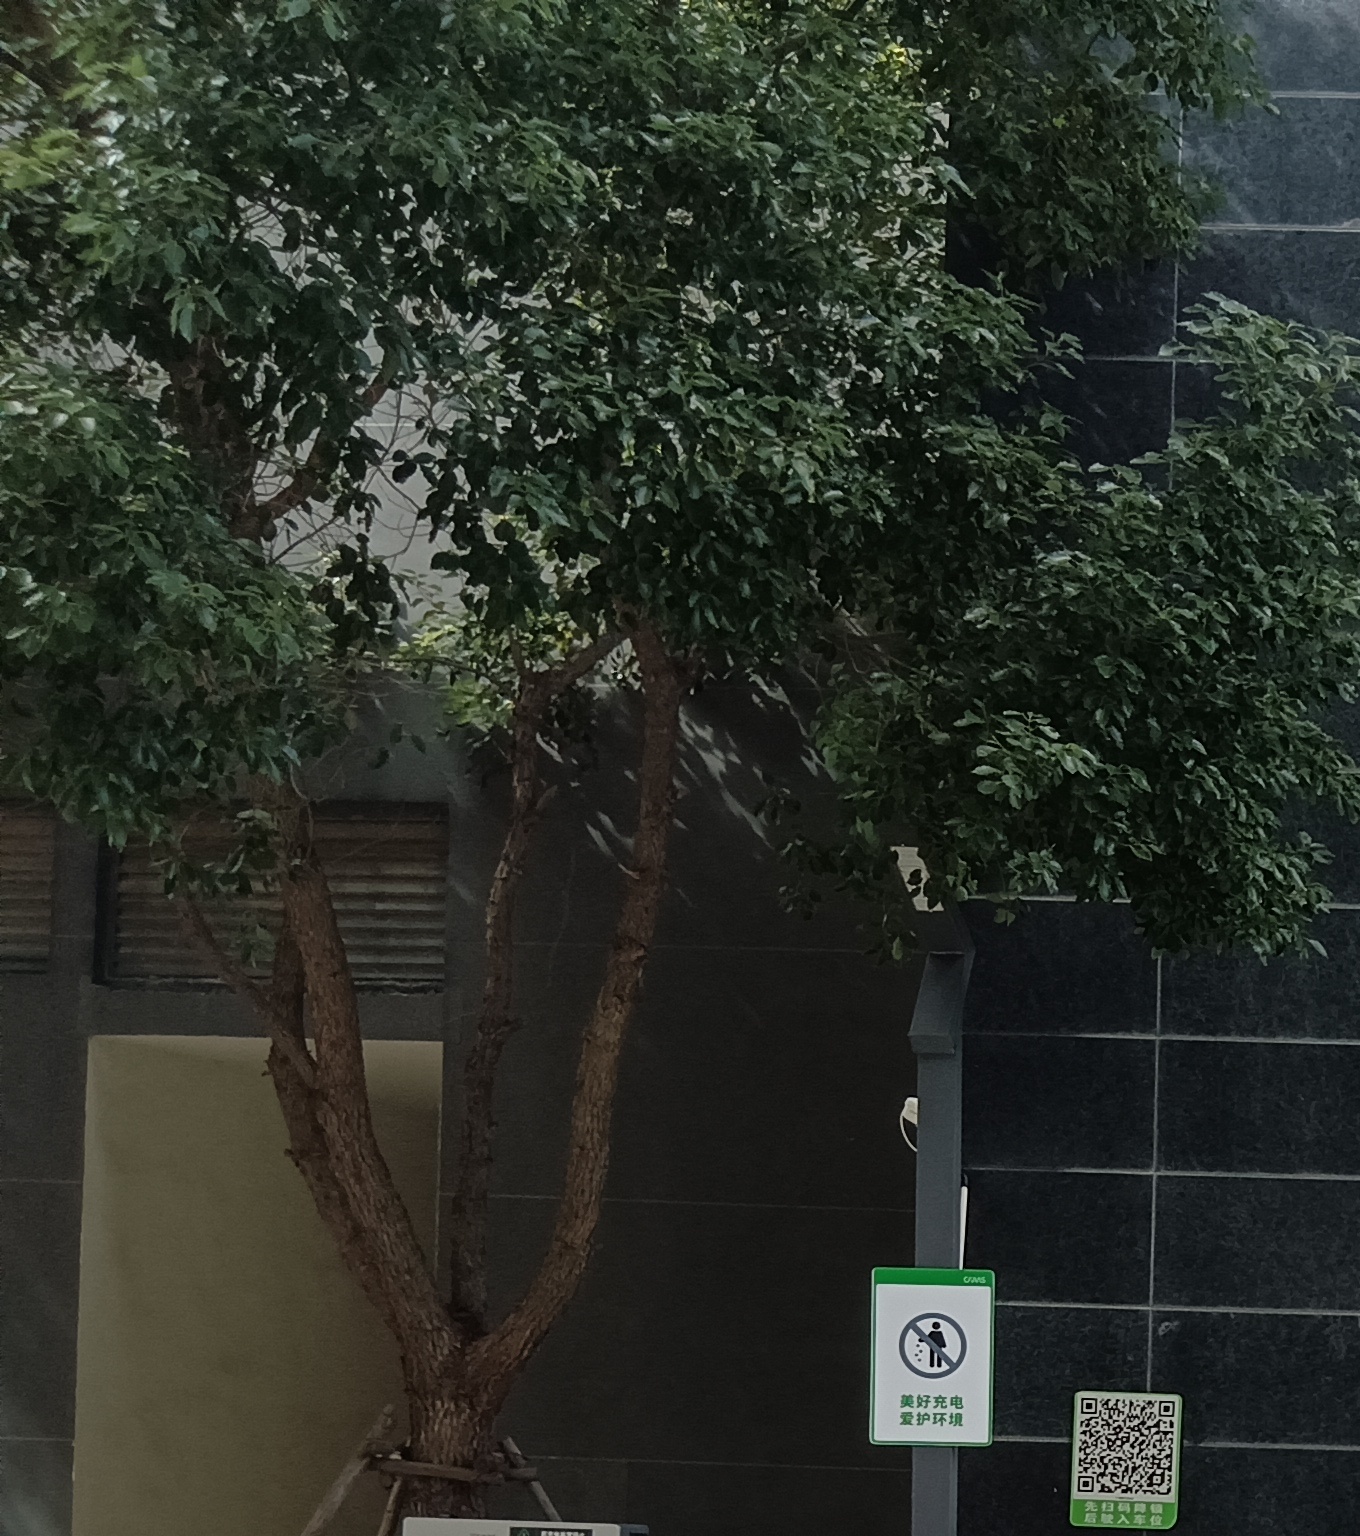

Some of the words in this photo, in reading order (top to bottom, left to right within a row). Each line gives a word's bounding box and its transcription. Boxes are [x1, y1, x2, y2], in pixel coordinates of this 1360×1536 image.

[900, 1394, 964, 1409] 美好充电
[900, 1412, 964, 1426] 爱护环境
[1084, 1501, 1163, 1513] 先扫码降锁
[1084, 1513, 1163, 1526] 后驶入车位
